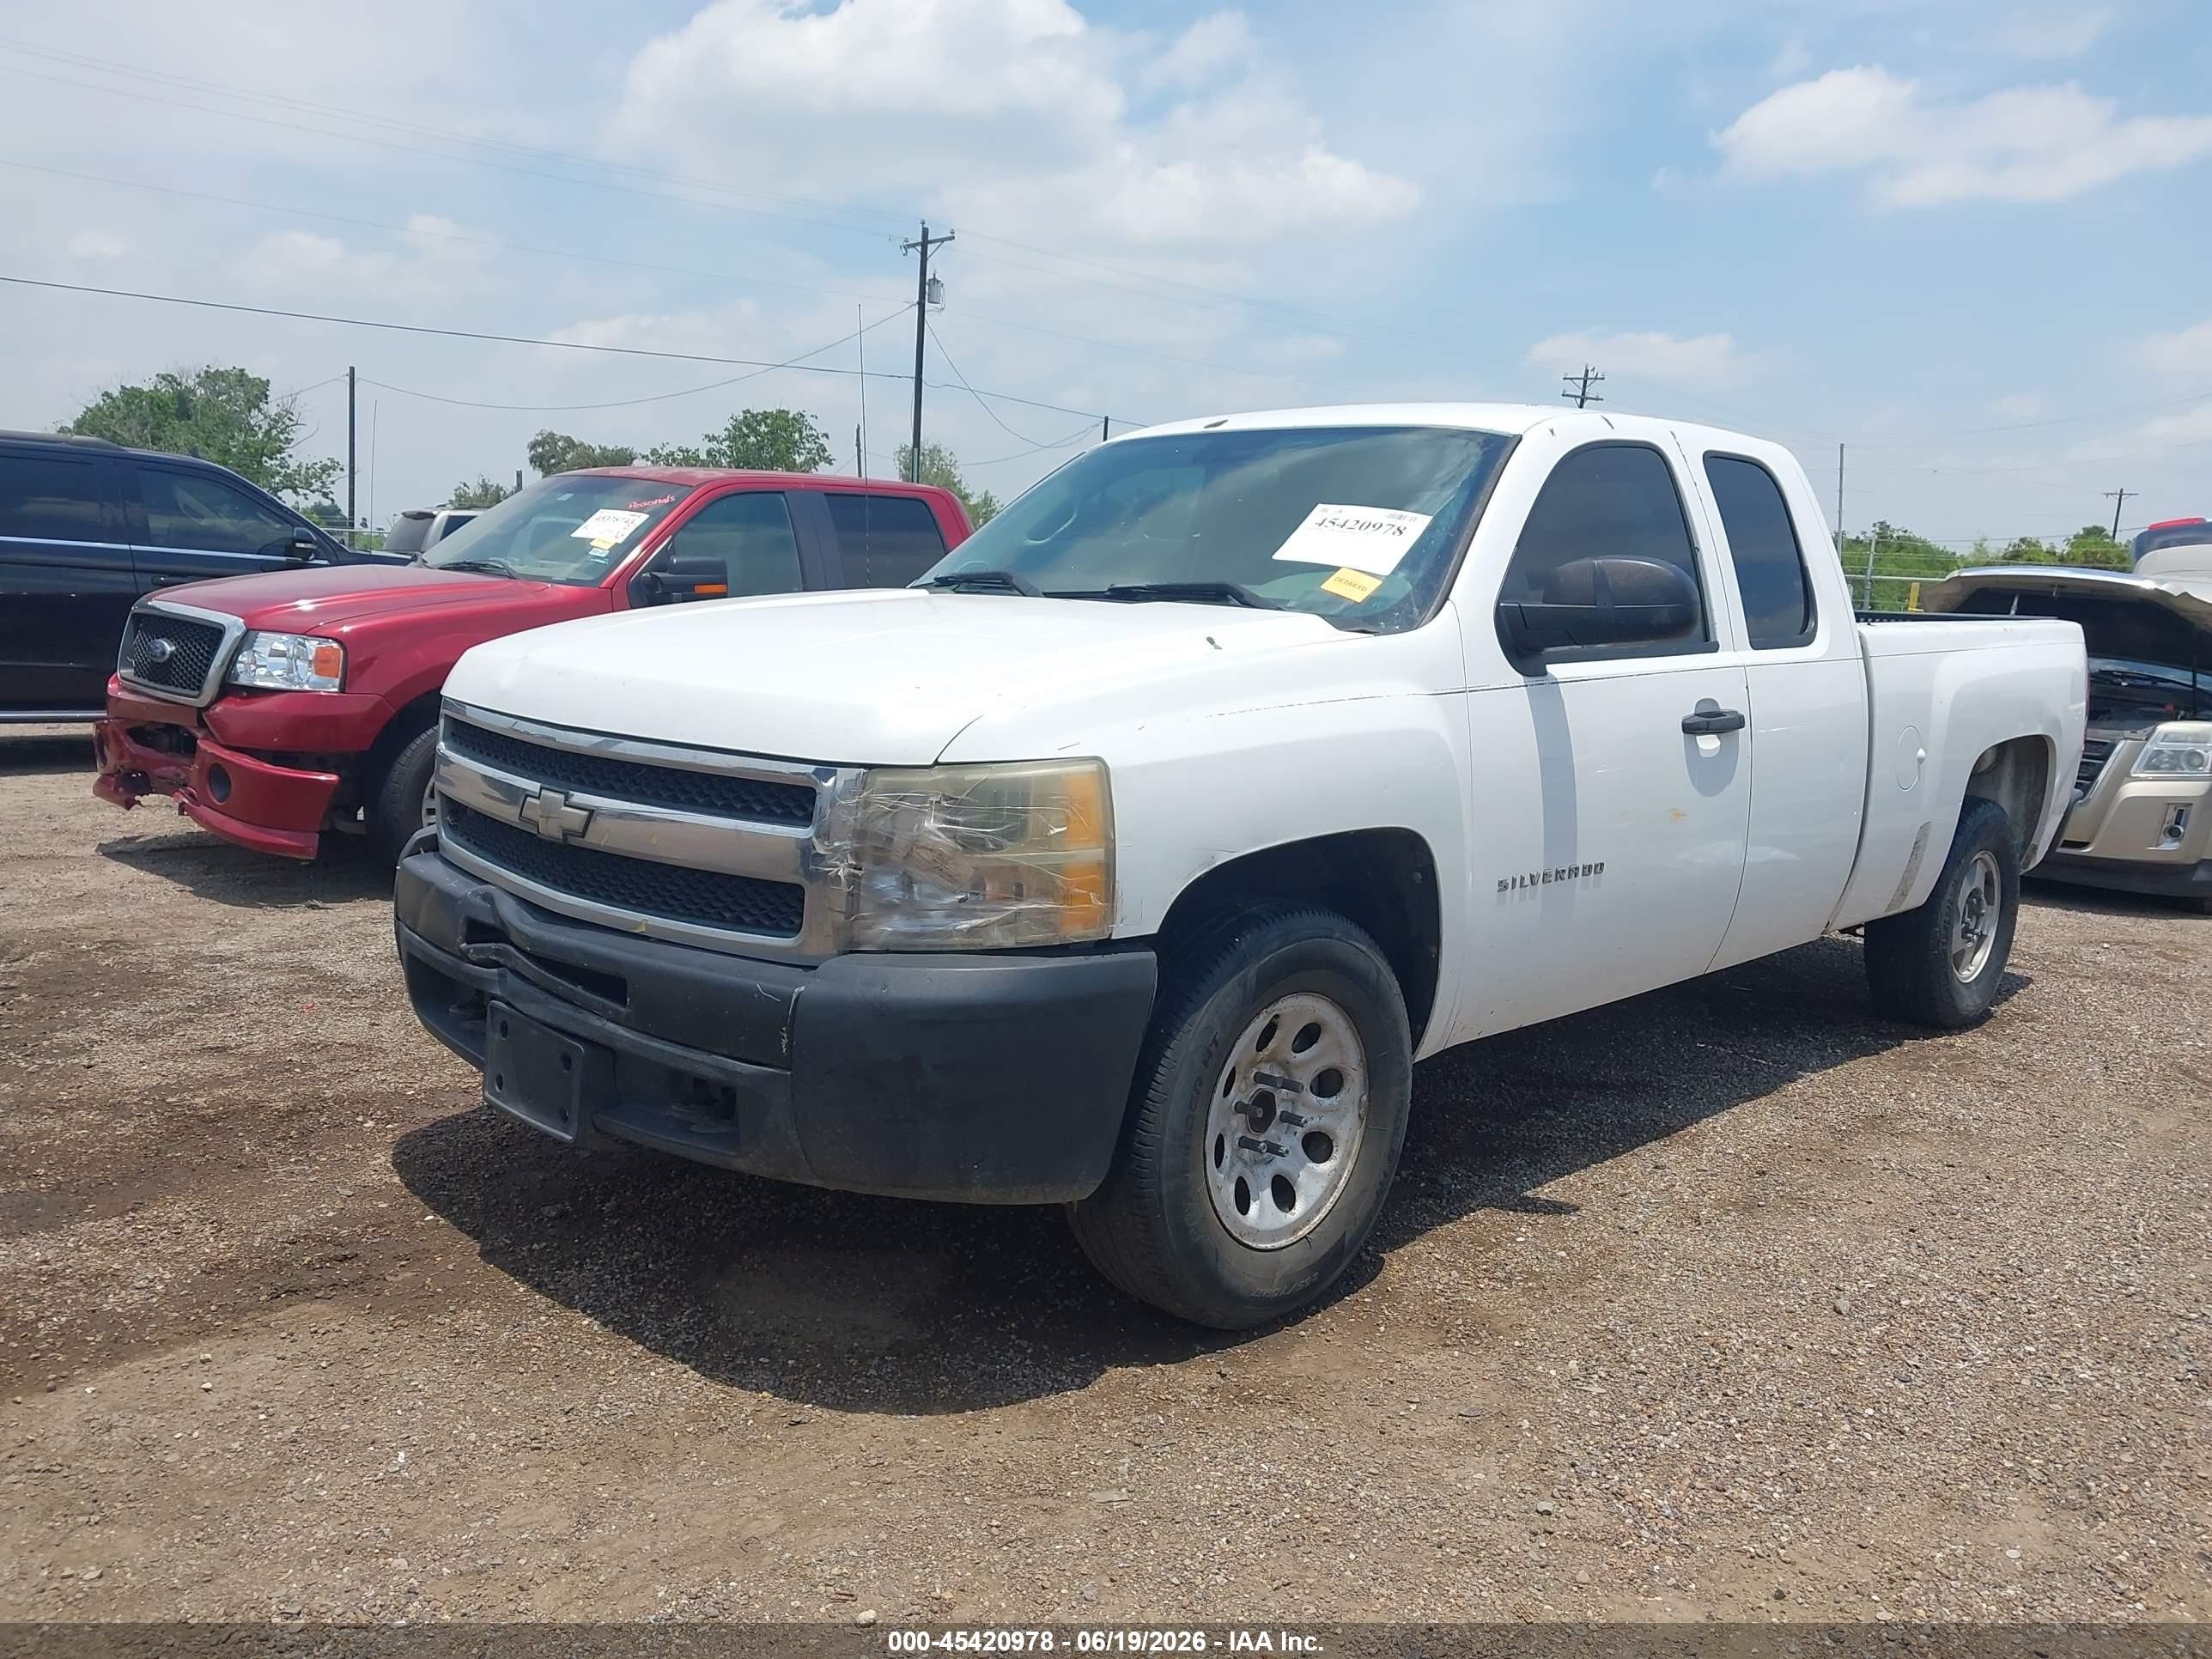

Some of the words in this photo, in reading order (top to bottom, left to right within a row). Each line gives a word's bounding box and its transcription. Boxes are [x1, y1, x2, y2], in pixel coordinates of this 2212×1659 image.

[1315, 517, 1407, 536] 45420978
[1334, 576, 1368, 592] DETAILED
[1497, 860, 1605, 892] SILVERADO
